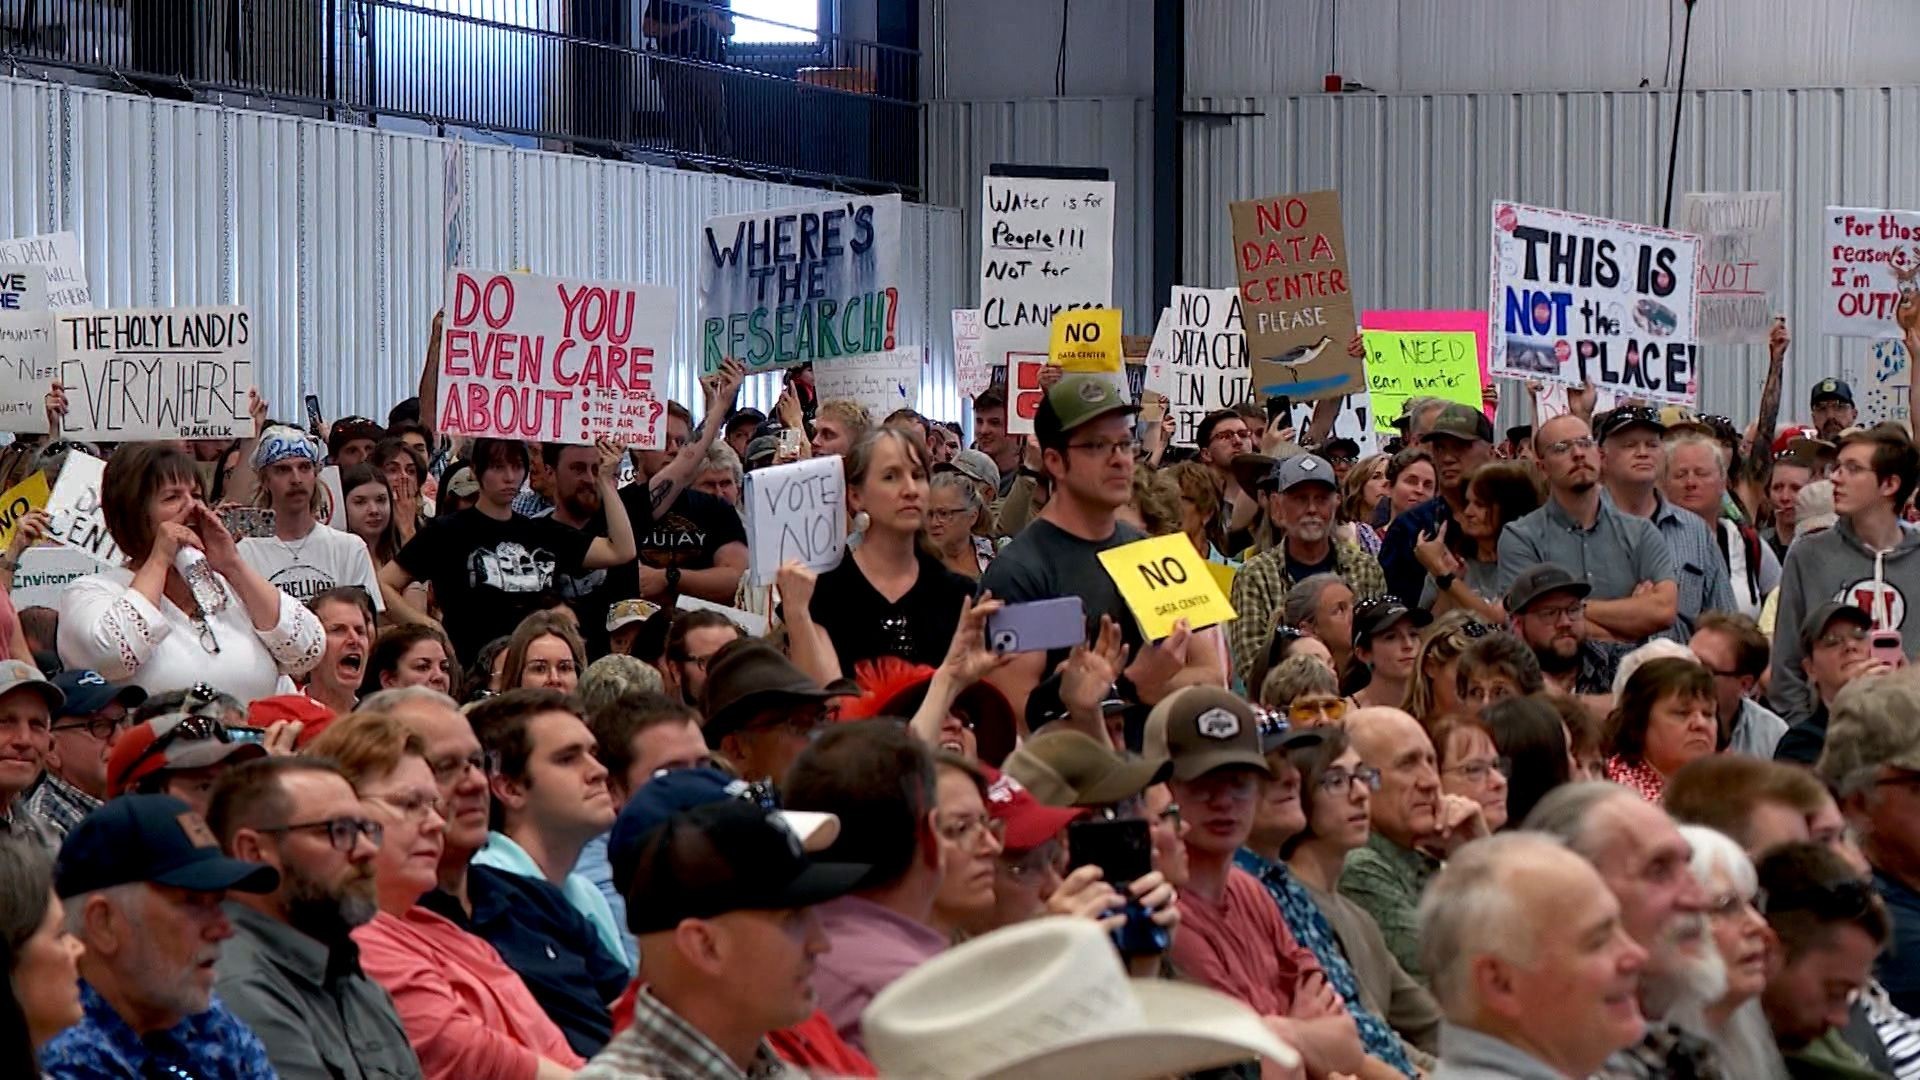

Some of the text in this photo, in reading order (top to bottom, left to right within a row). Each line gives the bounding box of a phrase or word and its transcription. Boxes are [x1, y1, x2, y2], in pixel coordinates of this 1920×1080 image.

[1083, 192, 1105, 208] for
[1255, 197, 1308, 237] NO
[704, 201, 875, 269] WHERE'S
[1240, 232, 1337, 273] DATA
[1041, 260, 1071, 278] for
[1512, 224, 1677, 297] THIS IS
[1700, 262, 1759, 291] NOT
[1831, 266, 1870, 288] I'm
[749, 259, 828, 304] THE
[1243, 268, 1348, 304] CENTER
[453, 272, 636, 345] DO YOU
[983, 297, 1104, 330] CLANK
[1179, 293, 1210, 328] NO
[1256, 306, 1329, 335] PLEASE
[1505, 285, 1621, 337] NOT the
[1837, 292, 1899, 320] OUT!
[62, 313, 249, 350] THE HOLY LAND IS
[1064, 322, 1101, 344] NO
[1172, 329, 1209, 368] DATA
[444, 328, 655, 393] EVEN CARE
[1057, 351, 1106, 360] DATA CENTER
[1399, 337, 1466, 364] NEED
[1575, 338, 1697, 397] PLACE!
[61, 357, 252, 431] EVERYWHERE
[595, 388, 618, 400] THE
[1174, 371, 1205, 406] IN
[1413, 369, 1466, 389] water
[440, 382, 573, 438] ABOUT
[592, 417, 634, 428] THE AIR
[594, 401, 614, 414] THE
[620, 404, 647, 418] LAKE
[765, 474, 839, 516] VOTE
[0, 496, 31, 538] NO
[780, 508, 838, 567] NO!
[1136, 556, 1188, 591] NO
[1154, 594, 1211, 616] DATA CENTER
